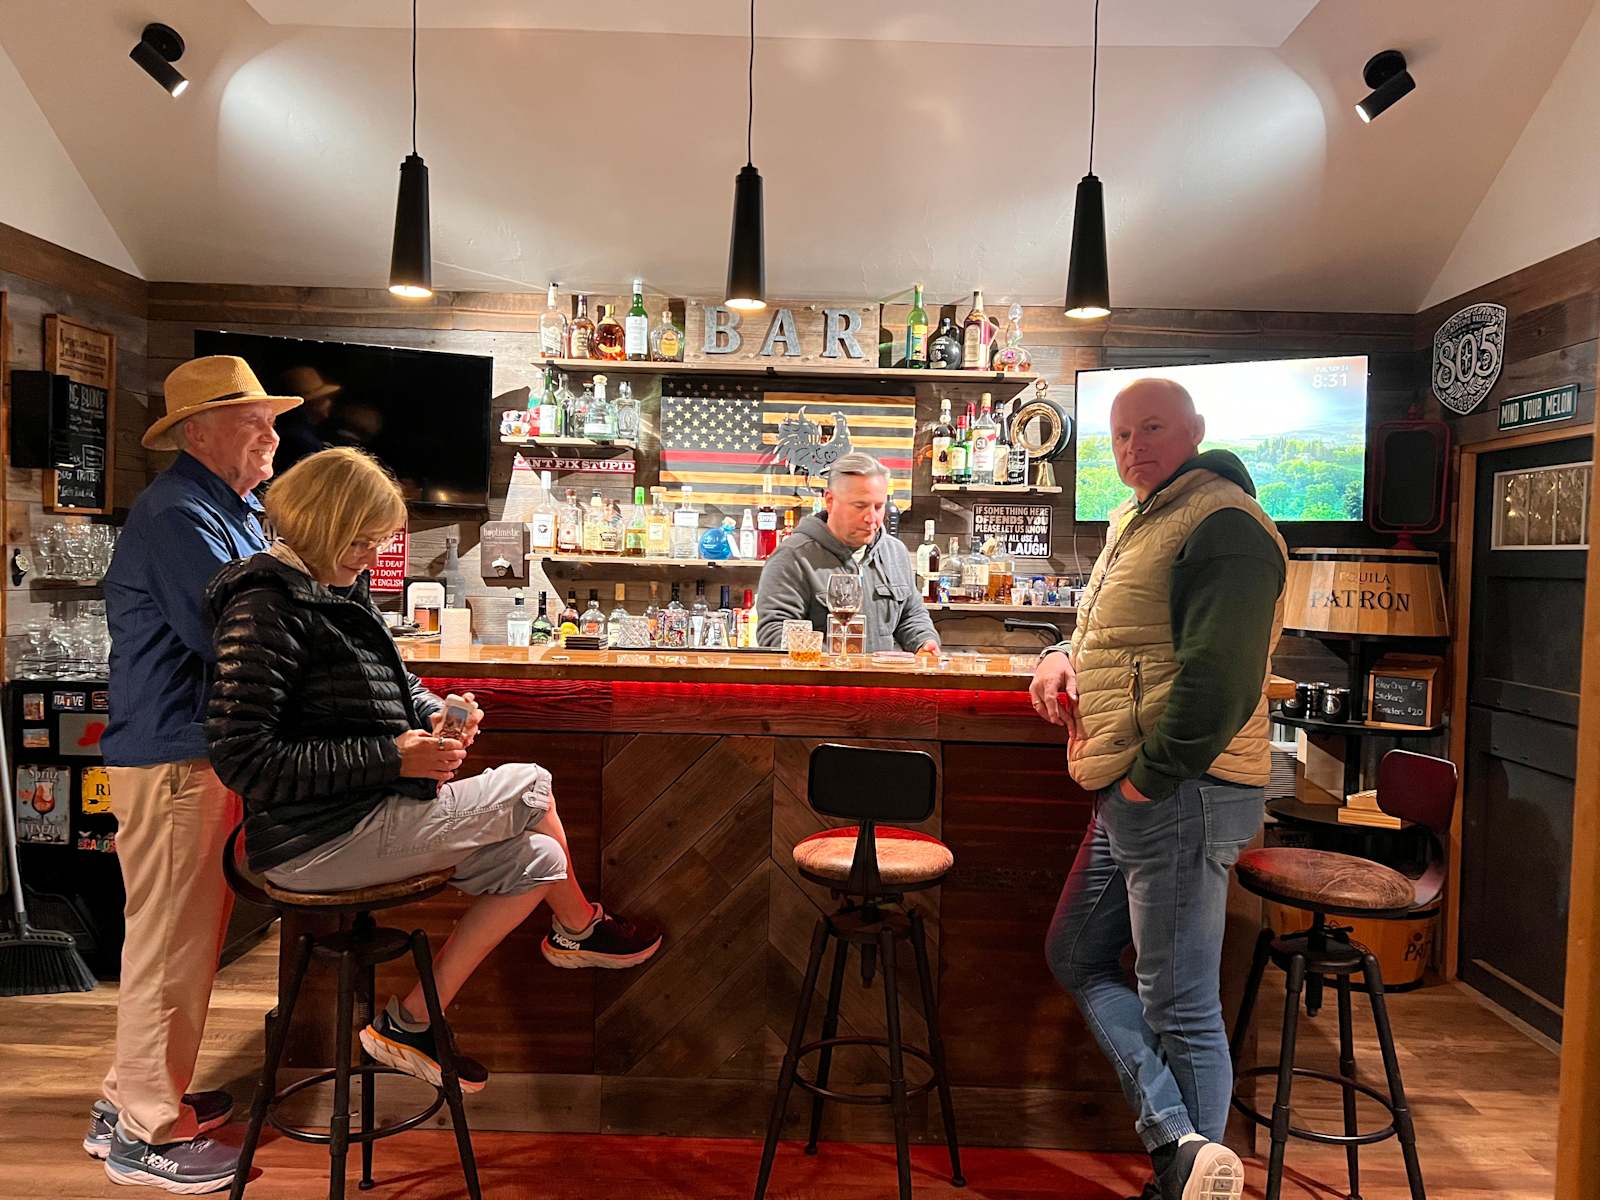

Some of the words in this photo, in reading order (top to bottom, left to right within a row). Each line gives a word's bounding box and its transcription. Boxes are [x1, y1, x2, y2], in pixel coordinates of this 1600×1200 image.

[703, 304, 864, 358] BAR
[1437, 324, 1498, 389] 805
[1312, 374, 1348, 388] 8:31
[1501, 402, 1519, 424] MIND
[1523, 398, 1542, 420] YOUR
[1545, 391, 1572, 416] MELON
[555, 460, 580, 469] FIX
[581, 460, 635, 470] STUPID
[1029, 508, 1049, 516] HERE
[975, 515, 1024, 524] OFFENDS
[1026, 516, 1048, 525] YOU
[975, 525, 1000, 533] PLEASE
[1001, 525, 1013, 533] LET
[1014, 525, 1024, 533] US
[1025, 526, 1048, 534] KNOW
[1008, 543, 1048, 555] LAUGH
[378, 579, 404, 587] ENGLISH
[1311, 586, 1410, 612] PATRÓN
[1408, 706, 1424, 716] $20
[29, 767, 58, 780] Spritz
[552, 934, 580, 951] HOKA
